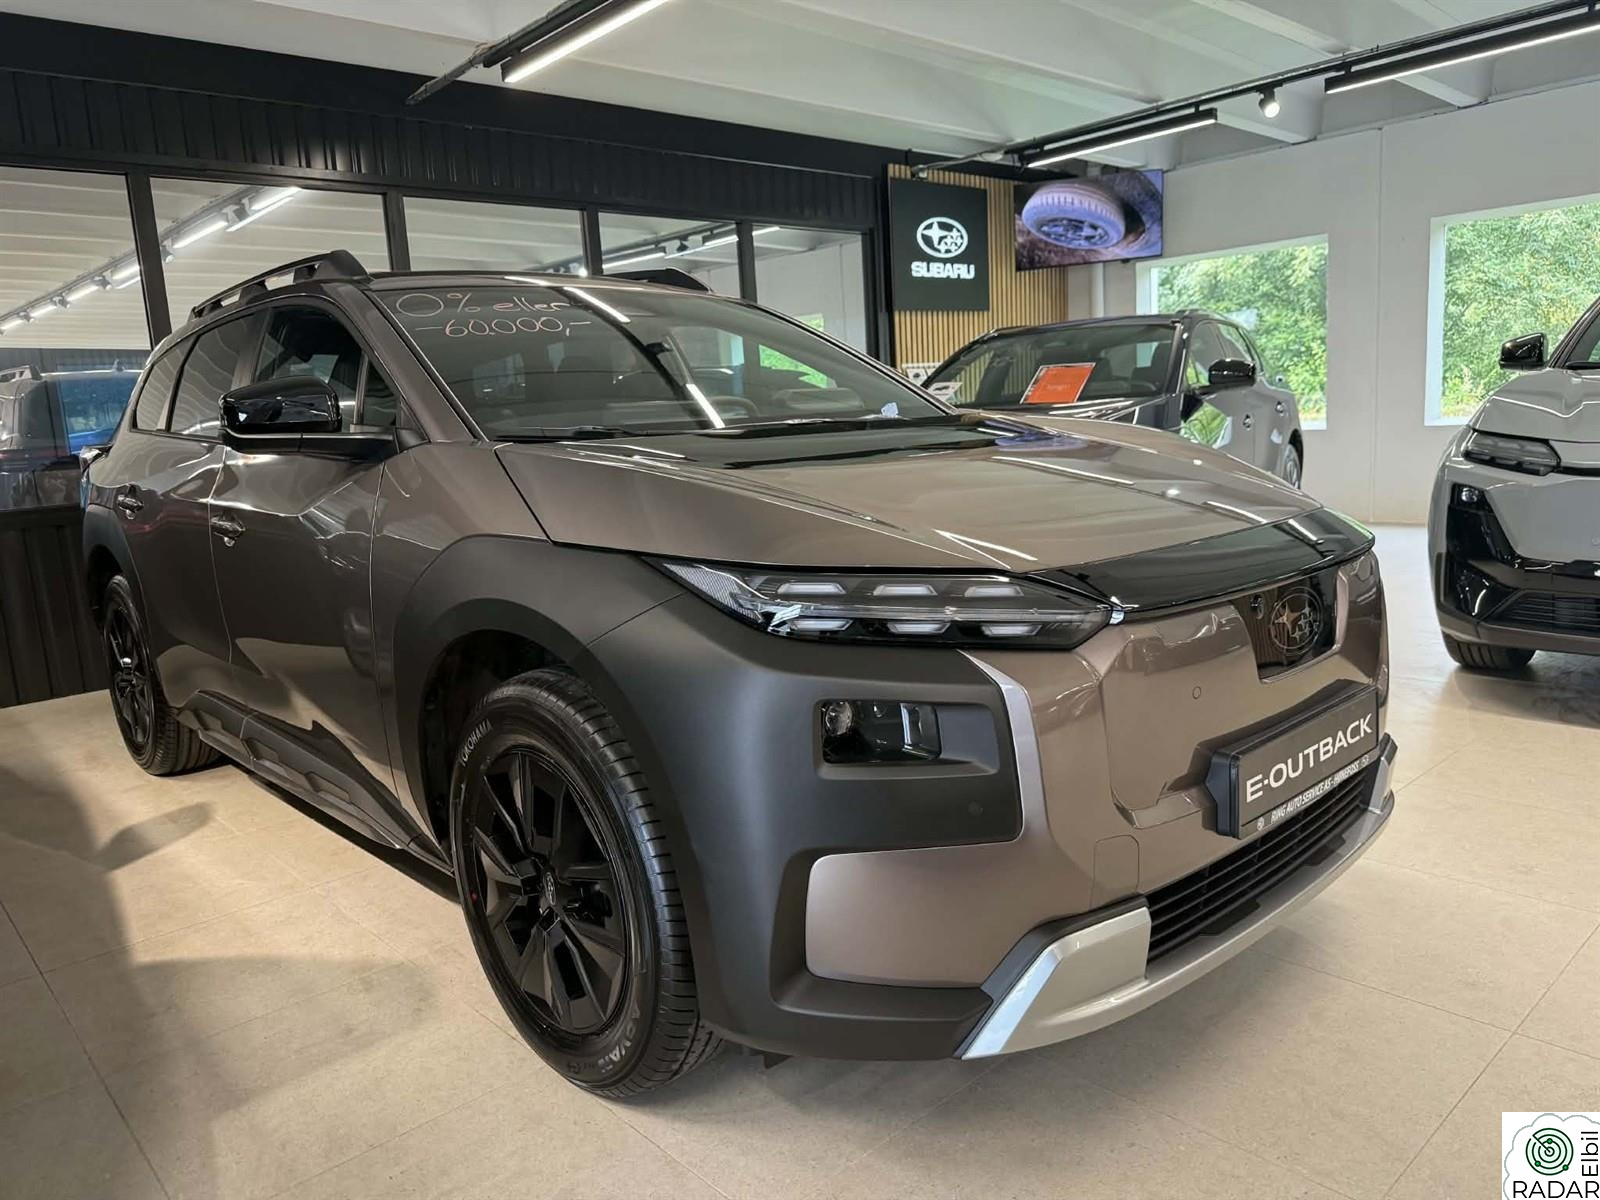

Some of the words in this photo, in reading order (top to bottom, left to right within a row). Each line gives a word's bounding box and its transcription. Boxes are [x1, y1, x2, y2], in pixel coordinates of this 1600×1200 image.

[911, 261, 975, 279] SUBARU
[396, 293, 472, 317] 0%
[493, 296, 570, 312] eller
[459, 719, 493, 767] YOKOHAMA
[1246, 713, 1372, 803] E-OUTBACK
[1286, 795, 1302, 813] AUTO
[1302, 782, 1324, 804] SERVICE
